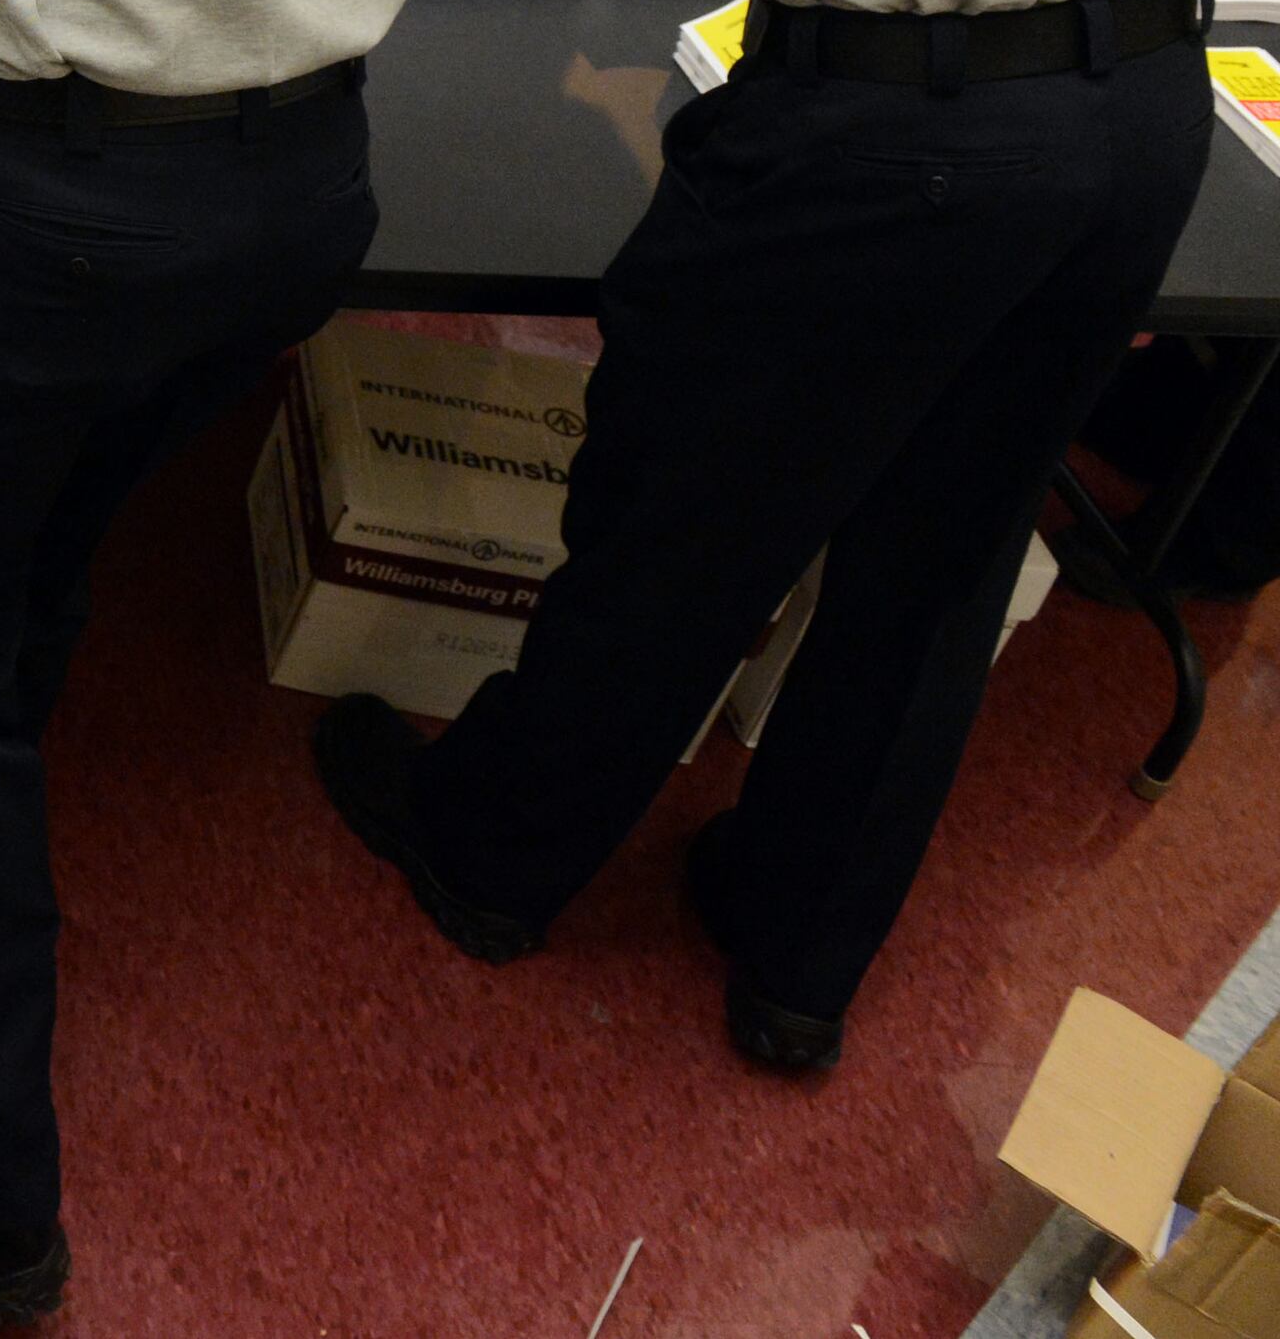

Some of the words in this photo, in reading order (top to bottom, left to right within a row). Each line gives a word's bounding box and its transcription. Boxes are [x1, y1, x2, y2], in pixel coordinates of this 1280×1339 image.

[360, 379, 541, 425] INTERNATIONAL
[354, 522, 471, 553] INTERNATIONAL
[343, 556, 508, 607] Williamsburg
